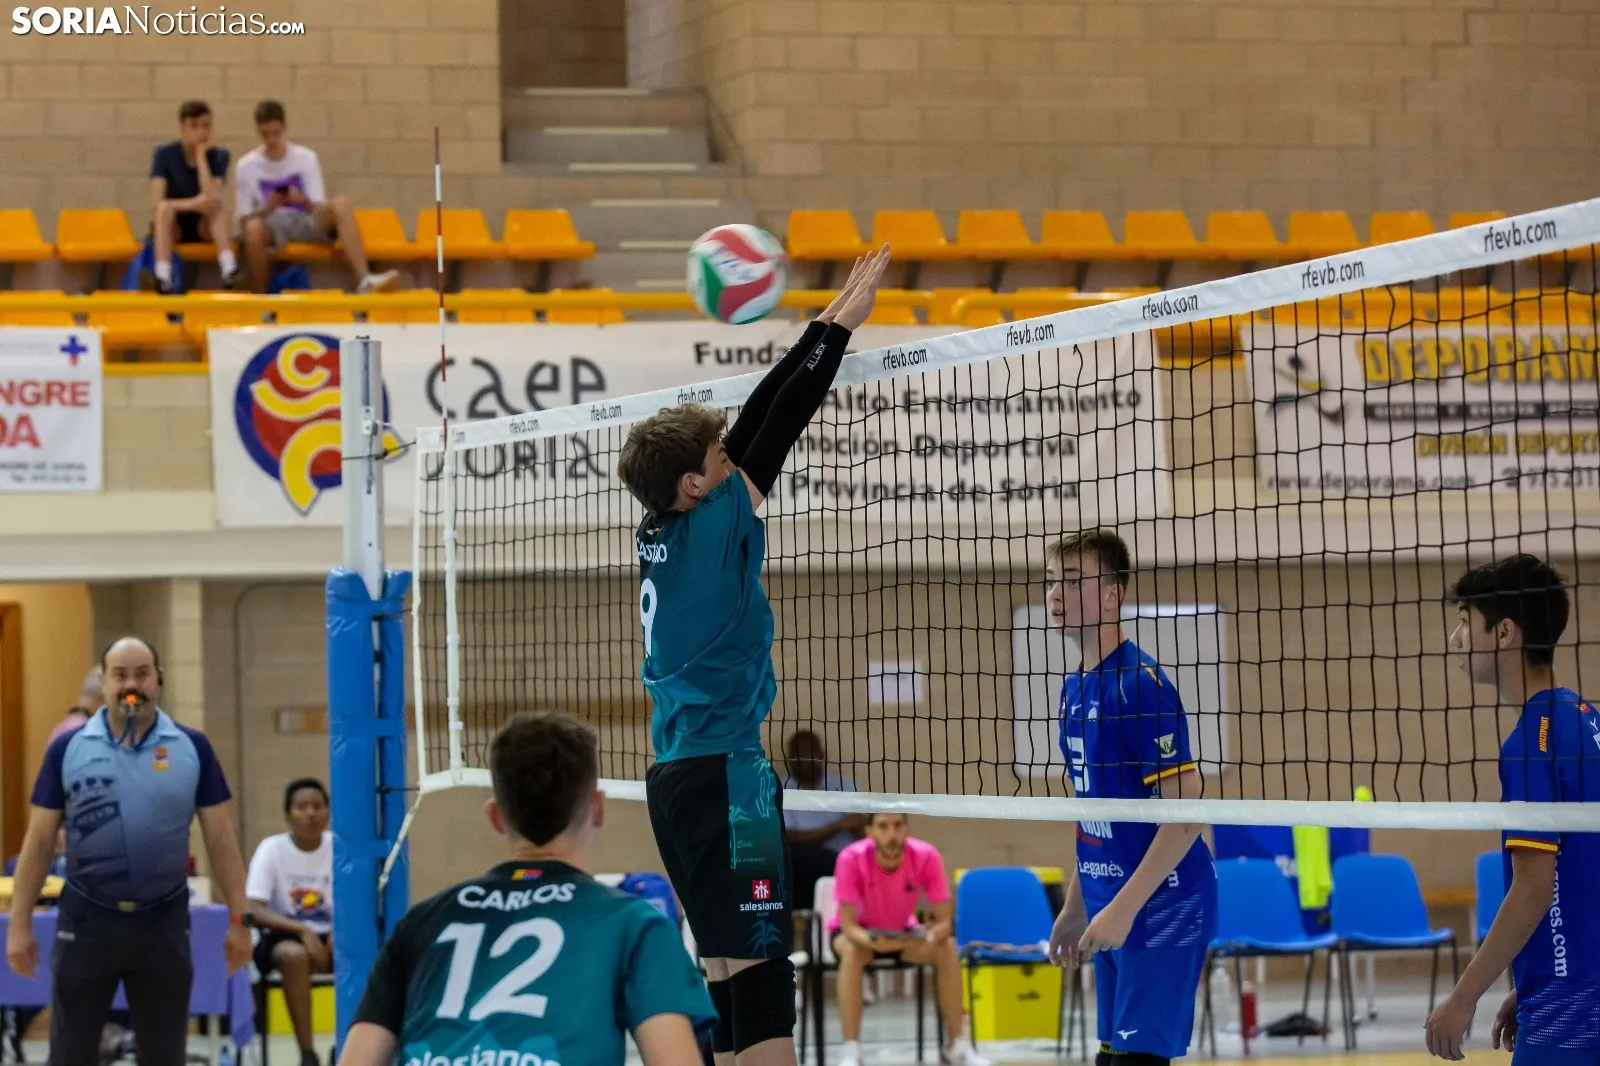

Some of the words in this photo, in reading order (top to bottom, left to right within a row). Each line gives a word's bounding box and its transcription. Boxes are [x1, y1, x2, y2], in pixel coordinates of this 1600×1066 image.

[1484, 220, 1557, 252] rfevb.com
[1301, 259, 1365, 289] rfevb.com
[1142, 292, 1198, 320] rfevb.com
[1006, 322, 1055, 346] rfevb.com
[807, 342, 828, 371] ALLSIX
[882, 347, 928, 370] rfevb.com
[591, 404, 622, 422] rfevb.com
[821, 388, 888, 412] Alto
[902, 387, 1141, 414] Entrenamiento
[914, 433, 1077, 464] Deportiva
[789, 475, 935, 502] Provincia
[948, 477, 985, 502] de
[999, 477, 1079, 502] Soria
[456, 882, 577, 912] CARLOS
[739, 901, 784, 911] salesianos
[435, 916, 566, 1022] 12
